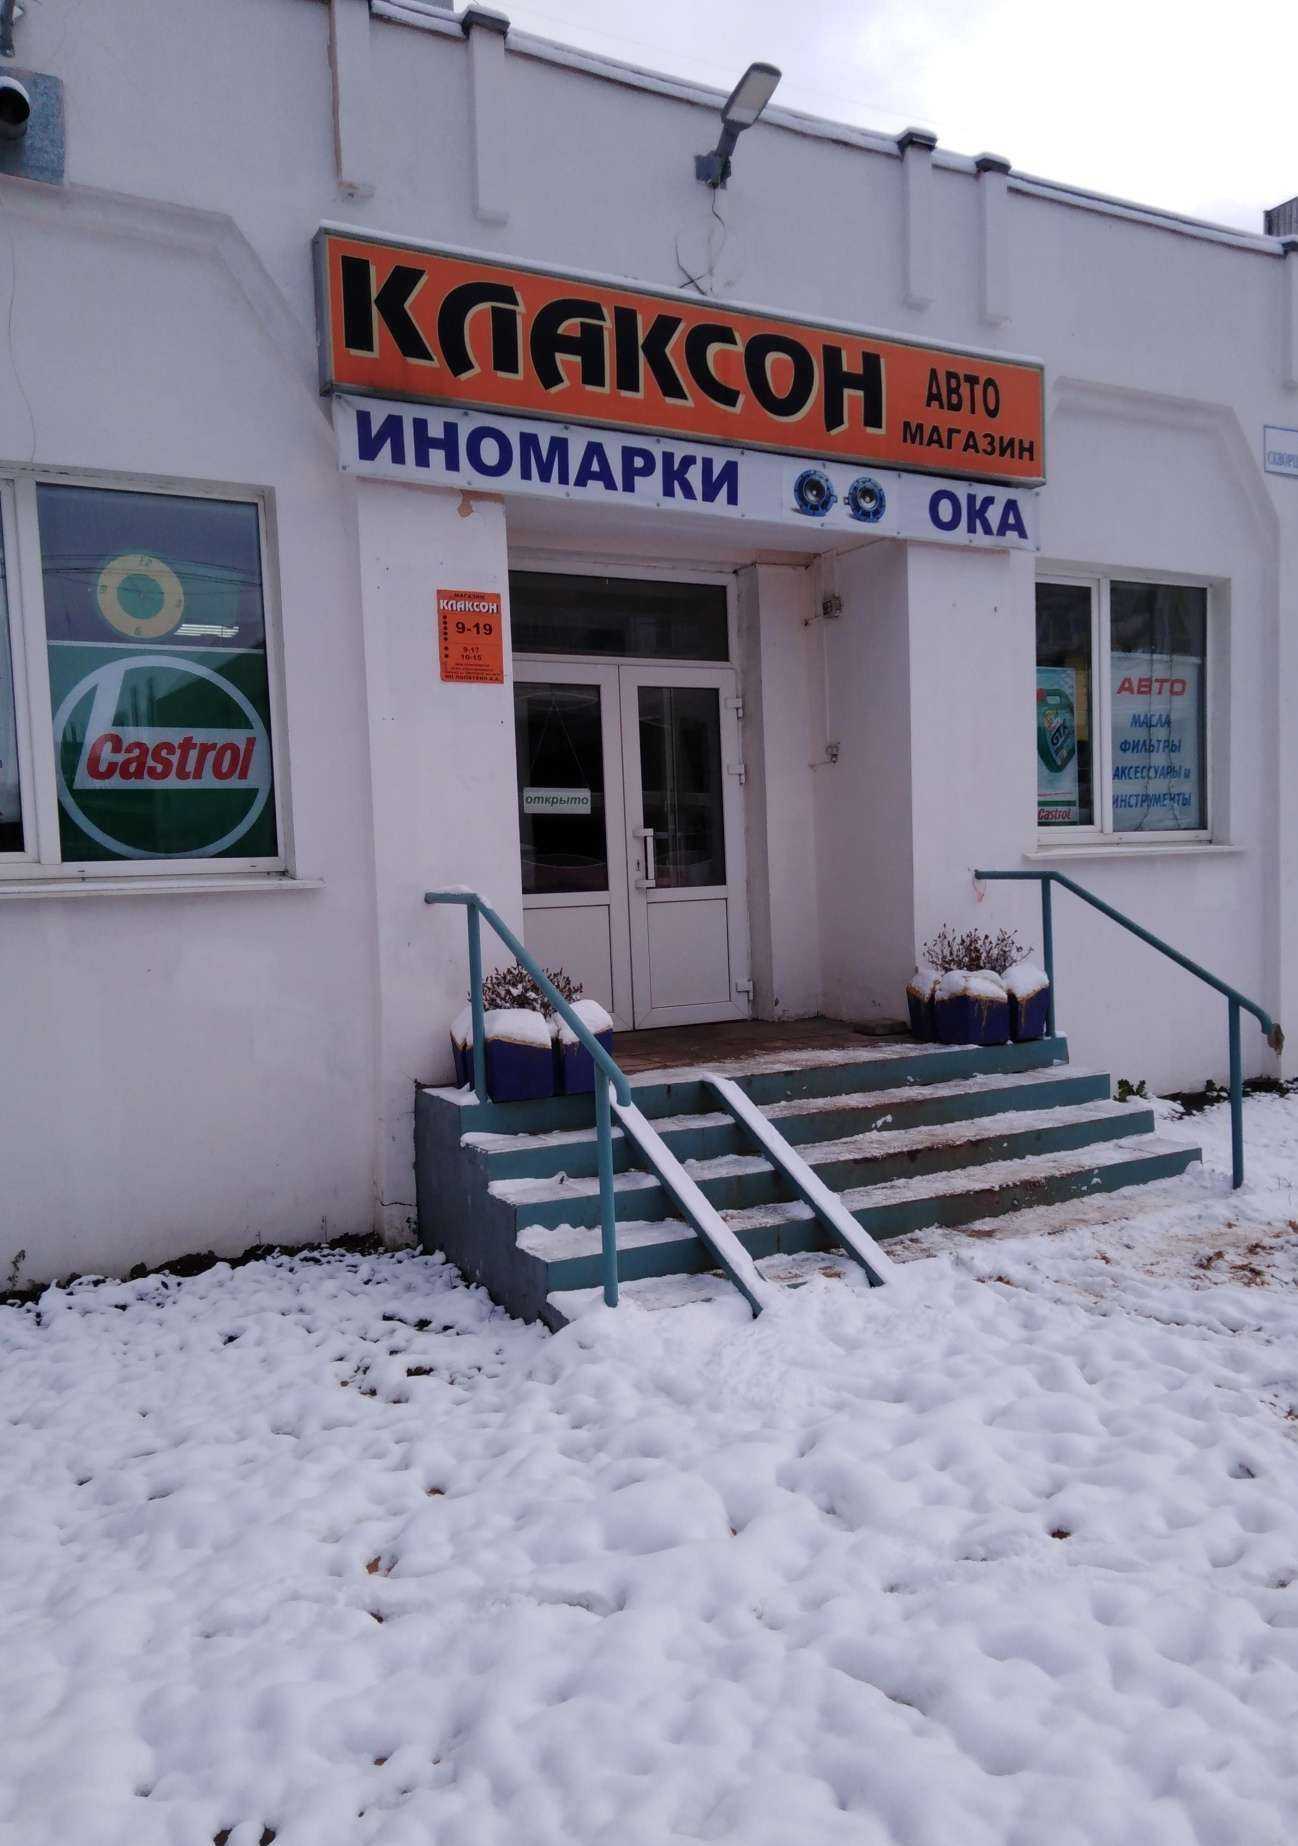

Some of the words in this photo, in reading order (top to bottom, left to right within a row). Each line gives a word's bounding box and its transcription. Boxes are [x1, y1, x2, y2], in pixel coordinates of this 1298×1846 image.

[341, 255, 886, 434] КЛАКСОН
[926, 367, 1000, 419] АВТО
[902, 421, 1035, 461] МАГАЗИН
[355, 410, 739, 506] ИНОМАРКИ
[928, 489, 1029, 540] ОКА
[440, 599, 497, 614] КЛАКСОН
[456, 621, 493, 635] 9-19
[1116, 677, 1188, 697] АВТО
[1130, 713, 1171, 728] МАСЛА
[1119, 739, 1182, 755] ФИЛЬТРЫ
[86, 732, 257, 781] Castrol
[1112, 765, 1182, 781] АКСЕССУАРЫ
[525, 796, 589, 807] открыто
[1112, 791, 1191, 809] ИНСТРУМЕНТЫ
[1037, 808, 1072, 821] Castrol
